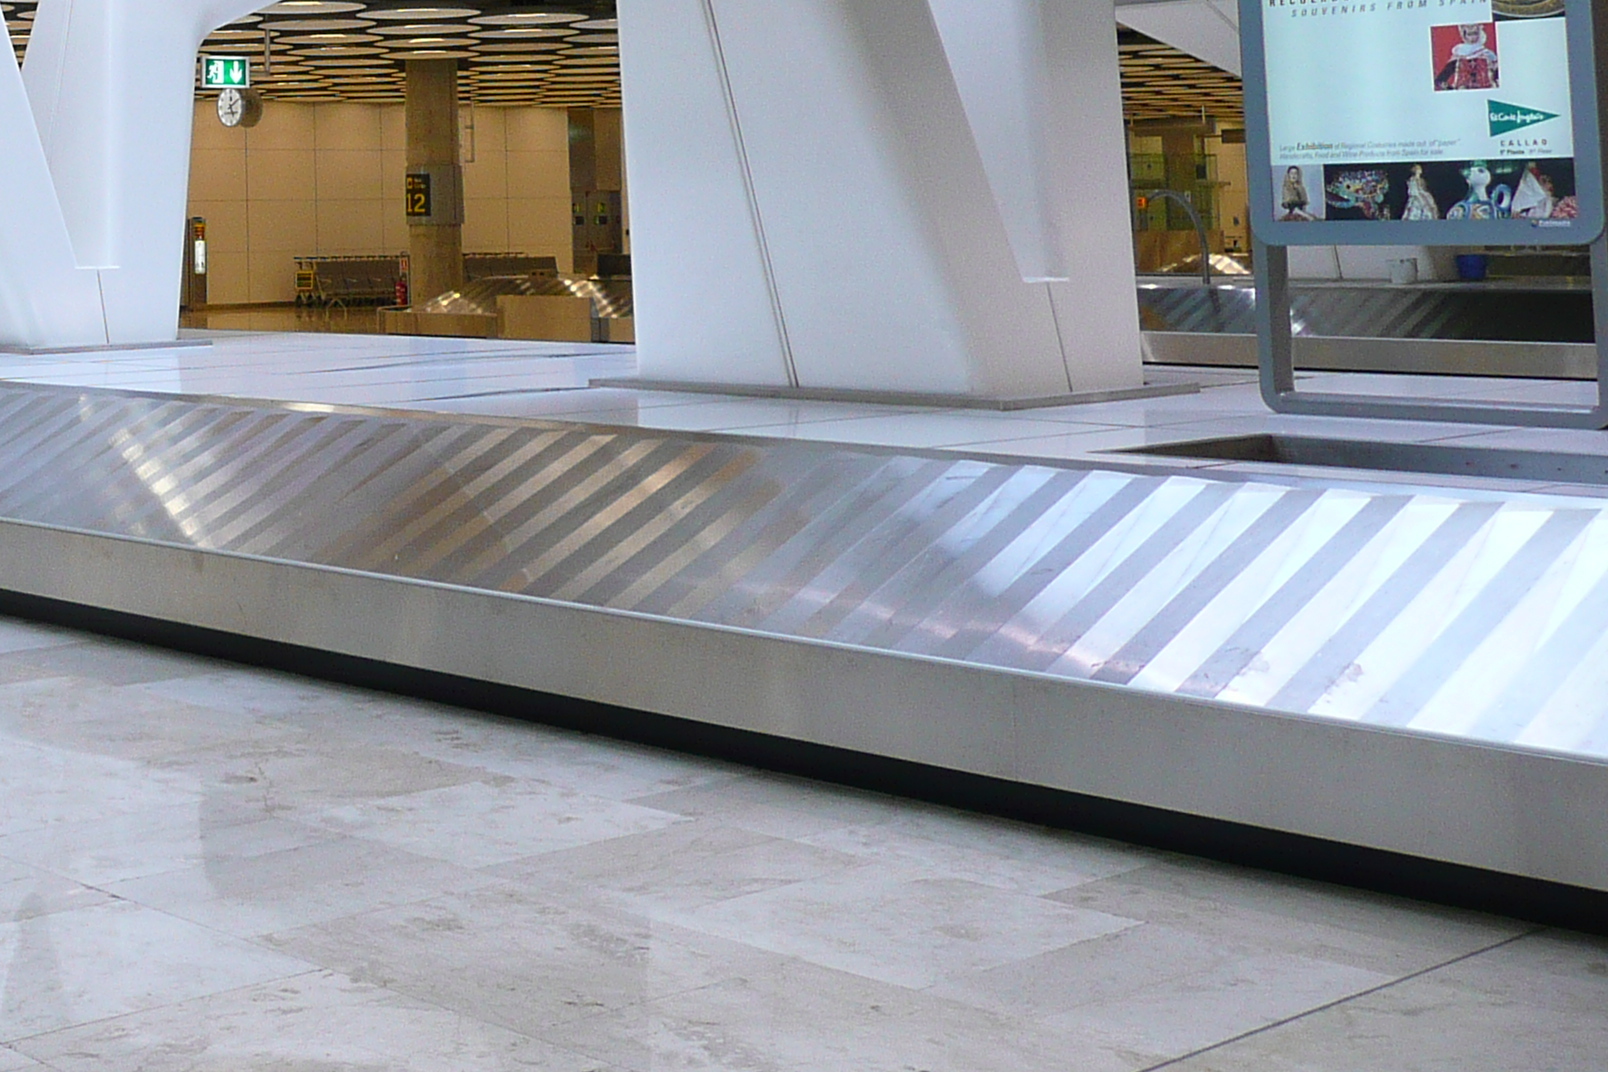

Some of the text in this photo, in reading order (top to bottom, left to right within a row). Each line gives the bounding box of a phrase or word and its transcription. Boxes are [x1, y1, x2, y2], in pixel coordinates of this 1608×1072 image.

[1291, 3, 1376, 18] SOUVENIRS
[1387, 0, 1428, 10] FROM
[1296, 141, 1333, 151] Exhibition
[1500, 138, 1547, 147] CALLAO
[407, 192, 426, 213] 12
